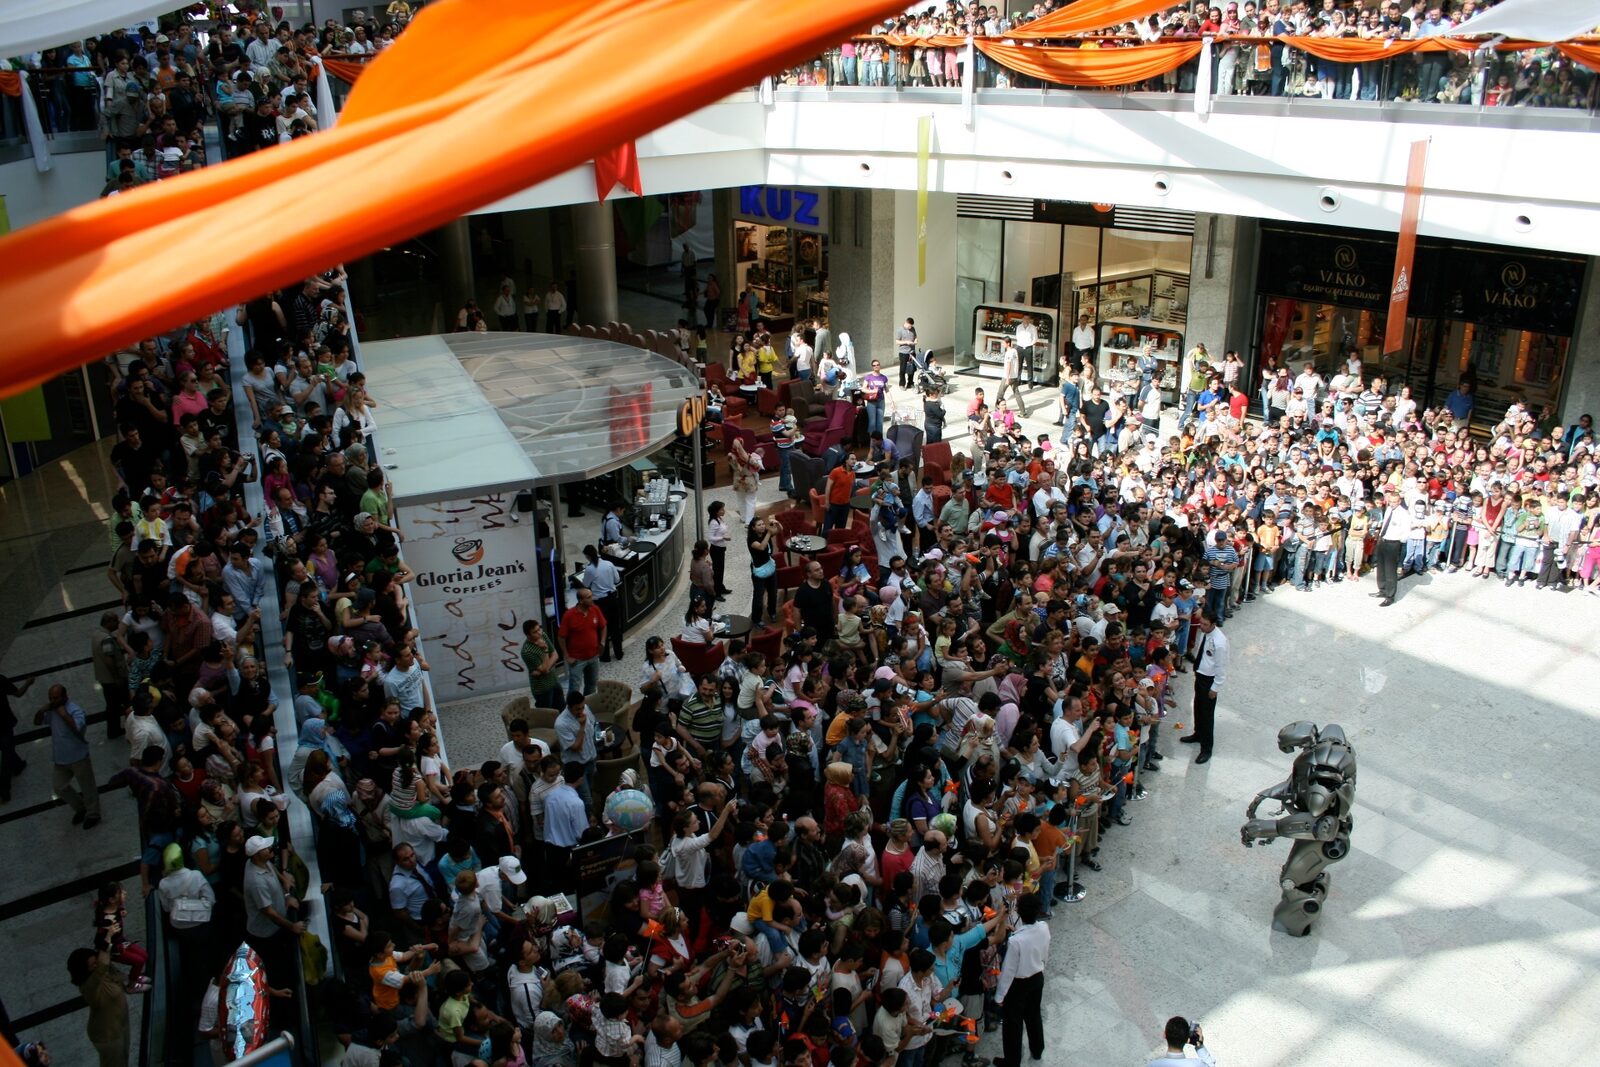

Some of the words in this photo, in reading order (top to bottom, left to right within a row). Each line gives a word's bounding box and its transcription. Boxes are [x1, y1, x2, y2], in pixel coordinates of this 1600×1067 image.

[740, 185, 819, 226] KUZ
[1320, 269, 1366, 288] VAKKO
[1485, 289, 1536, 309] VAKKO
[416, 568, 473, 588] Gloria
[476, 560, 525, 580] Jean's
[443, 579, 502, 594] COFFEES
